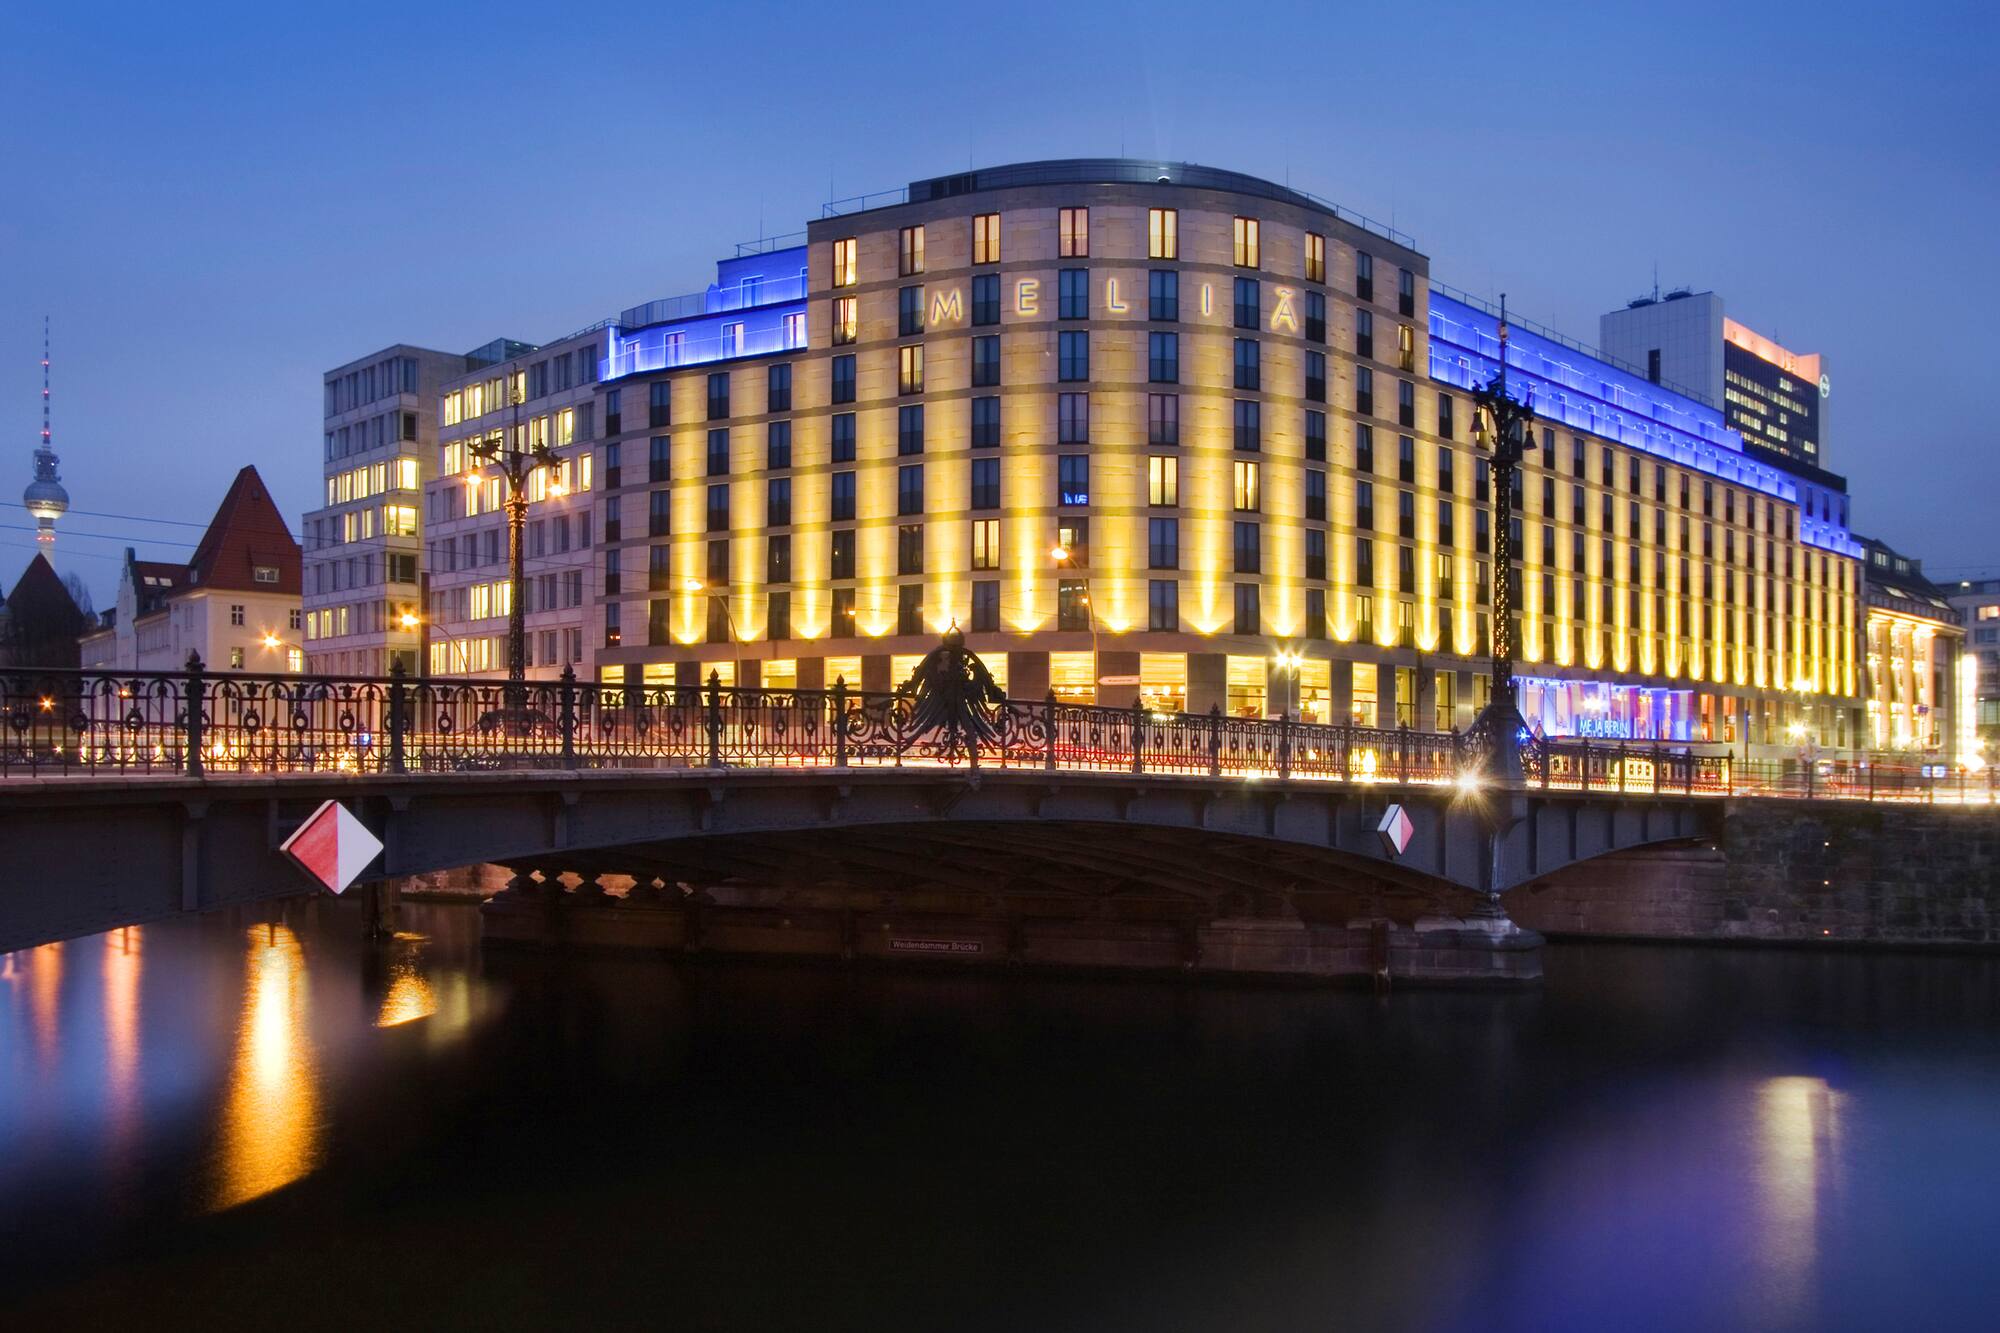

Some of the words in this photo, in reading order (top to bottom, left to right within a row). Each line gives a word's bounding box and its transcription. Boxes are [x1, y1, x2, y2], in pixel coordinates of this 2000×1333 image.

[1604, 719, 1629, 735] BERLIN
[892, 940, 950, 951] Weidendammer
[951, 941, 978, 952] Brücke
